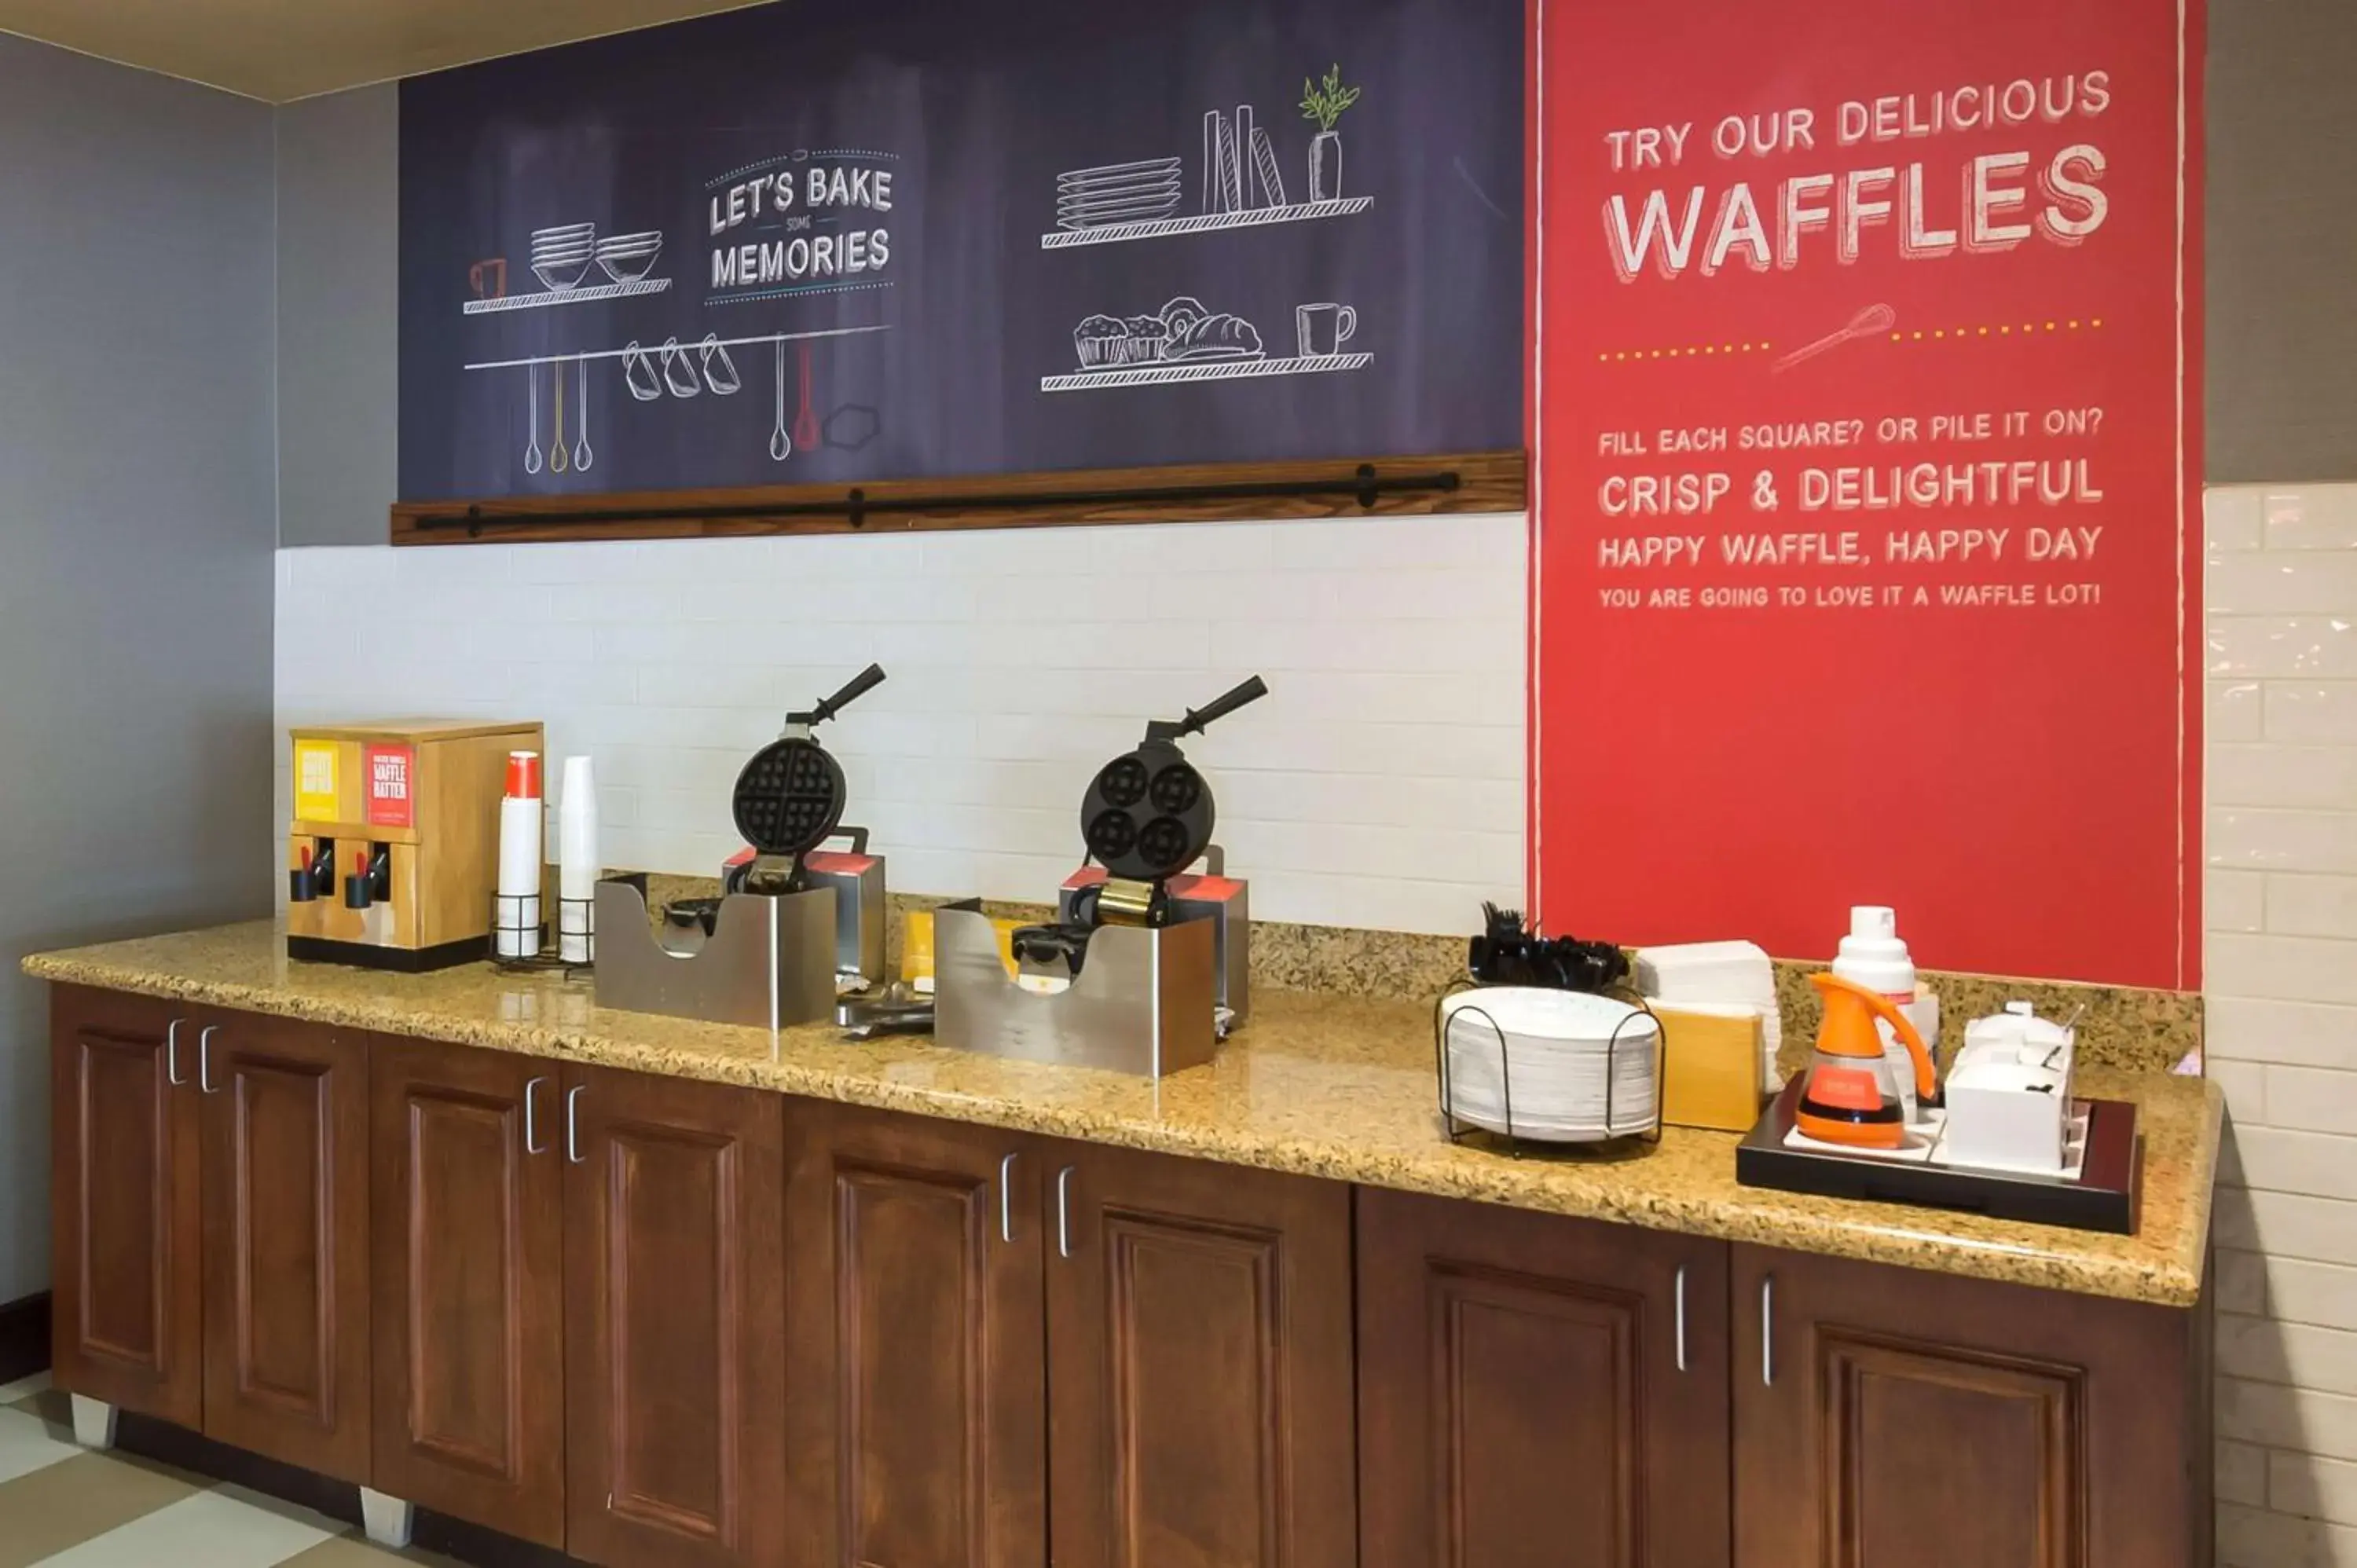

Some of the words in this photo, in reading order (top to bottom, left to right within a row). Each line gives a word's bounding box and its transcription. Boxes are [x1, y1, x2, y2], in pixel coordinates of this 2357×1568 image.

[1605, 121, 1692, 171] TRY
[1712, 107, 1815, 157] OUR
[1836, 69, 2112, 146] DELICIOUS
[709, 171, 794, 236] LET'S
[807, 167, 893, 212] BAKE
[786, 215, 812, 232] SOME
[1601, 142, 2109, 284] WAFFLES
[711, 228, 890, 288] MEMORIES
[1599, 431, 1647, 456] FILL
[1658, 427, 1727, 453] EACH
[1739, 420, 1864, 452] SQUARE?
[1877, 417, 1918, 443] OR
[1929, 413, 1991, 441] PILE
[2003, 412, 2029, 438] IT
[2044, 408, 2102, 437] ON?
[1599, 472, 1730, 516] CRISP
[1750, 469, 1779, 510] &
[1798, 458, 2102, 510] DELIGHTFUL
[1599, 536, 1706, 568] HAPPY
[1721, 531, 1871, 566] WAFFLE,
[1886, 528, 2010, 563] HAPPY
[2025, 526, 2102, 562] DAY
[1600, 588, 1640, 608] YOU
[1648, 588, 1691, 608] ARE
[1699, 587, 1768, 607] GOING
[1779, 587, 1806, 606] TO
[1816, 586, 1872, 606] LOVE
[1882, 585, 1902, 606] IT
[1912, 585, 1929, 606] A
[1940, 584, 2035, 606] WAFFLE
[2046, 584, 2102, 605] LOT!
[373, 763, 406, 782] WAFFLE
